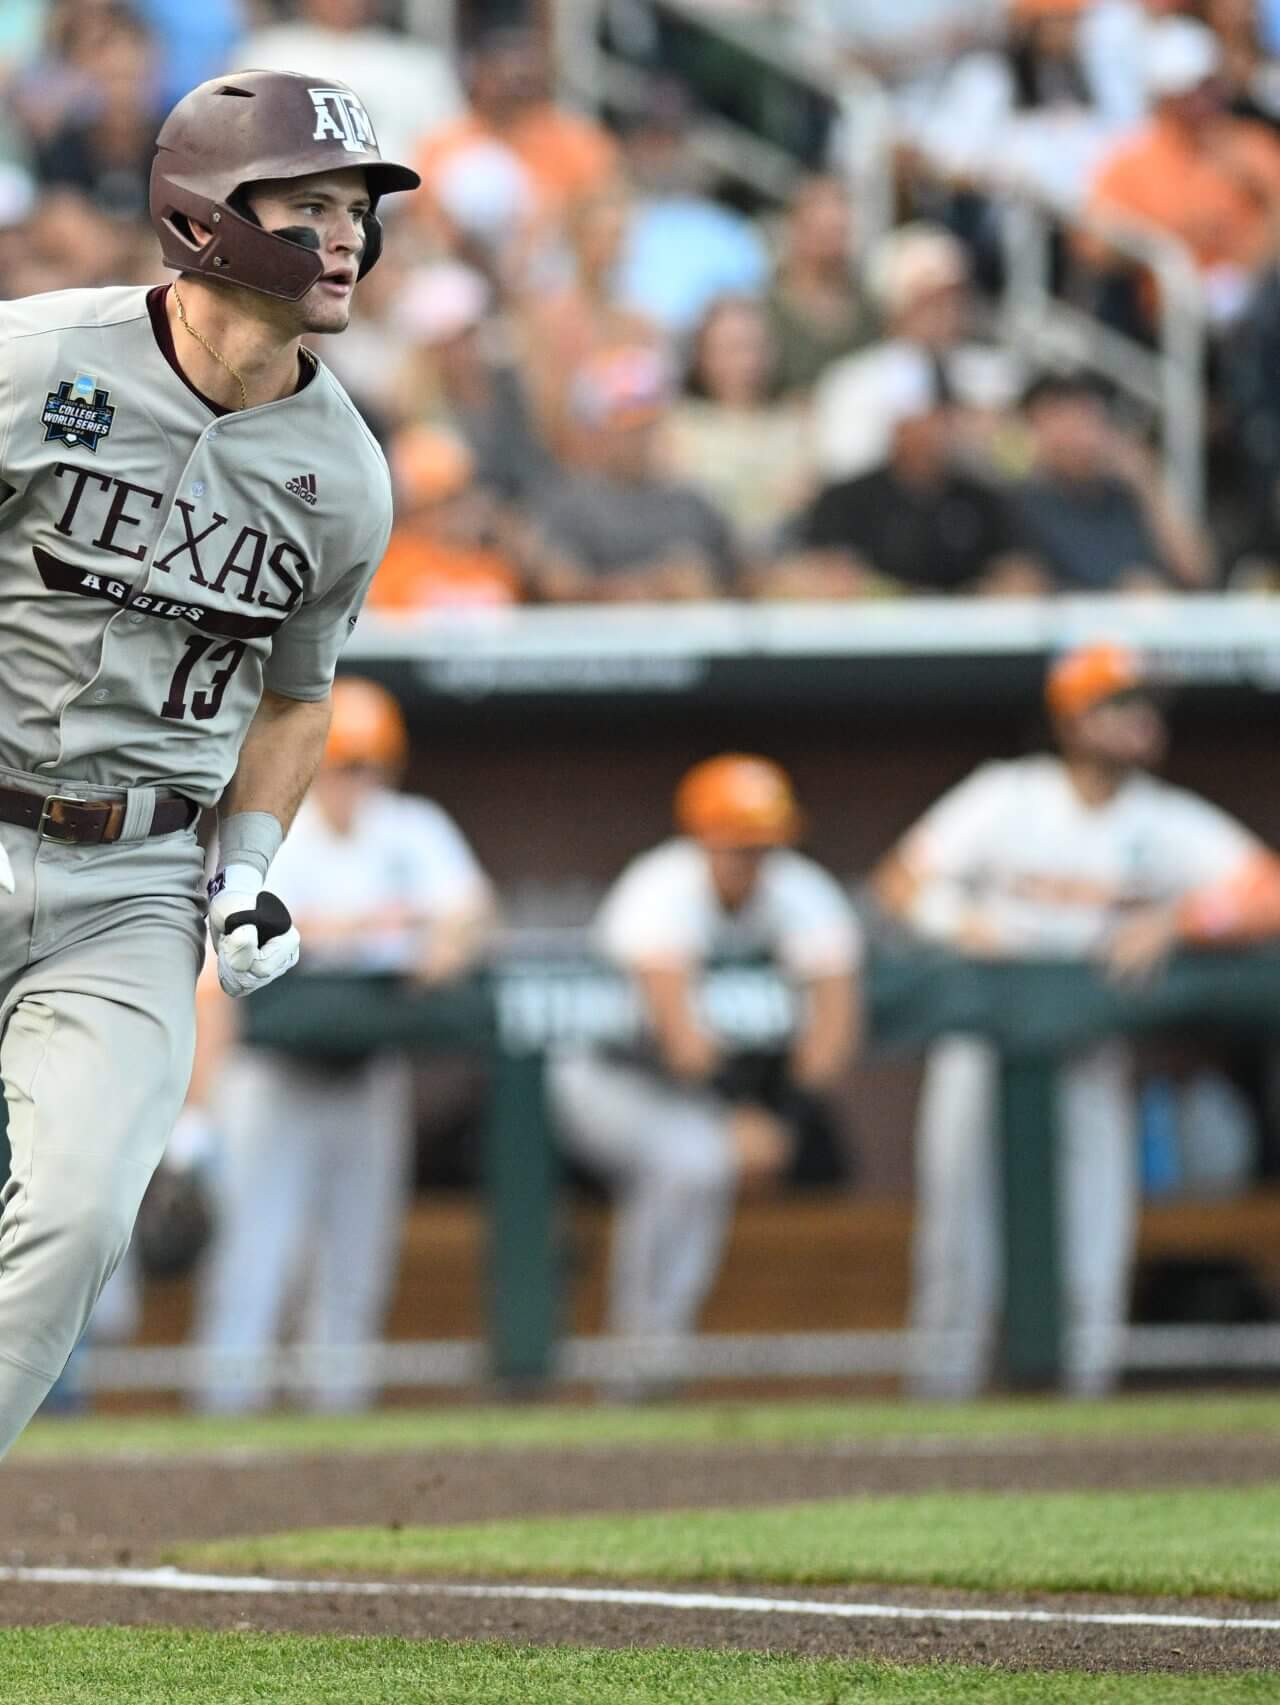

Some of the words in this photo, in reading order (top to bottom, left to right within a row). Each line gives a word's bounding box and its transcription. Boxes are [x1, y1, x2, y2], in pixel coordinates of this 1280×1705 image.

[43, 412, 76, 426] WORLD
[75, 419, 109, 434] SERIES
[58, 405, 98, 421] COLLEGE
[285, 481, 317, 506] adidas
[54, 461, 310, 612] TEXAS
[80, 572, 205, 622] AGGIES
[160, 634, 248, 721] 13
